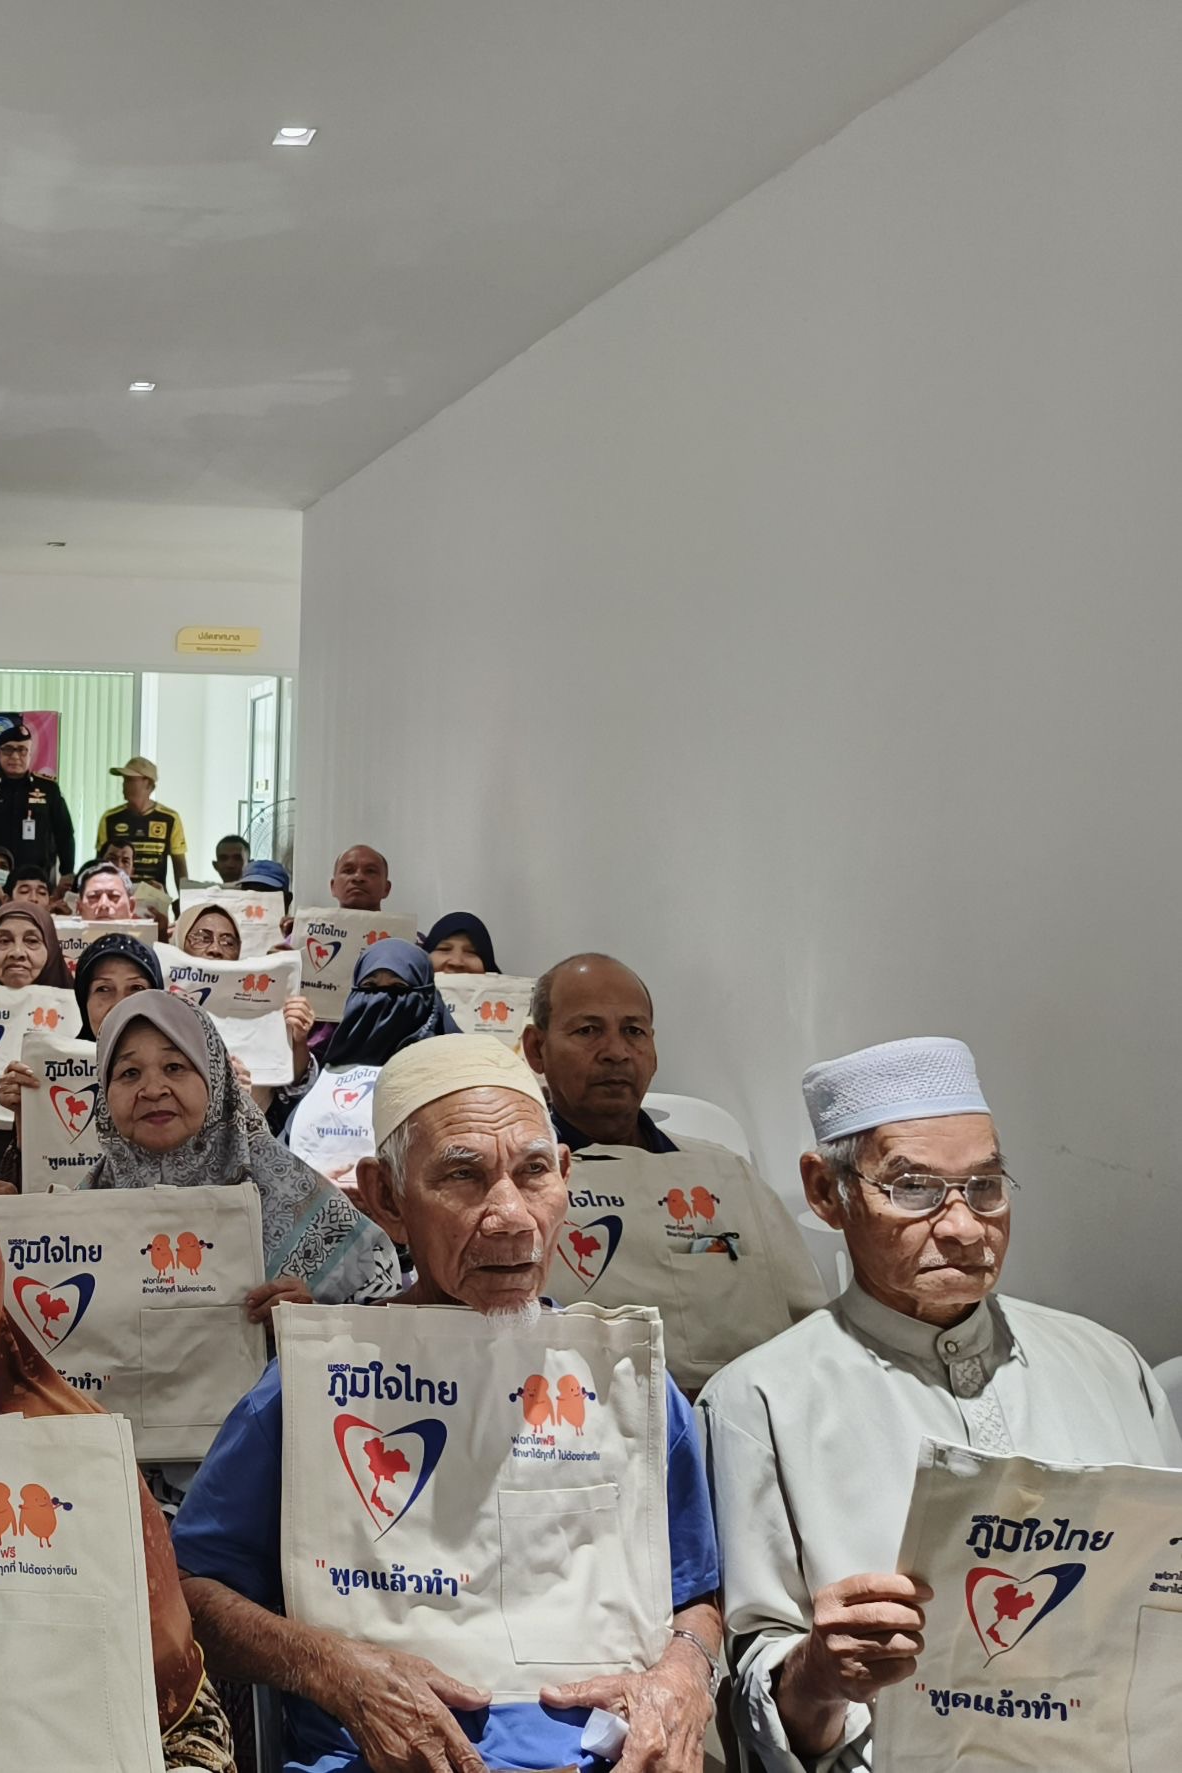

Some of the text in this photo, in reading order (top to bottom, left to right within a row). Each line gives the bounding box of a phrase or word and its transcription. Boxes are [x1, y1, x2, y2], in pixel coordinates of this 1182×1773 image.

[8, 1235, 102, 1270] ภูมิใจไทย
[327, 1360, 458, 1407] ภูมิใจไทย
[965, 1517, 1115, 1559] ภูมิใจไทย
[18, 1561, 78, 1576] ไม่ต้องจ่ายเงิน
